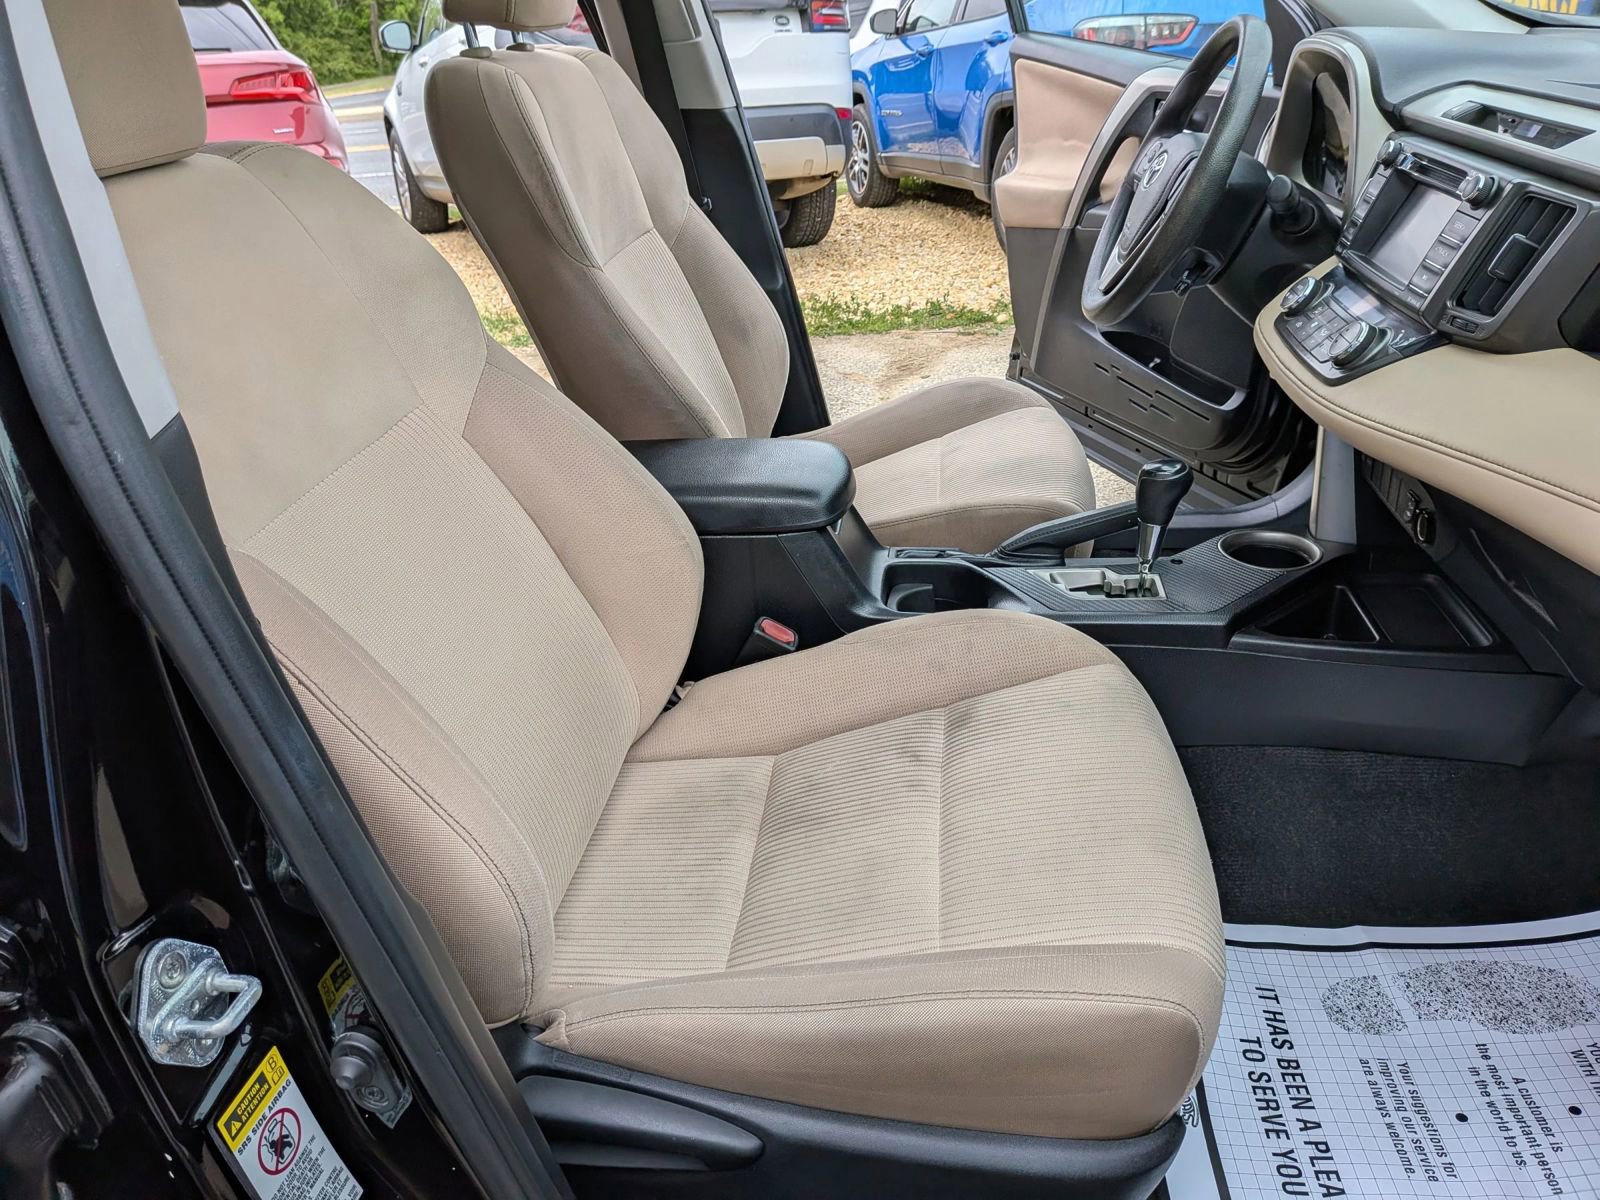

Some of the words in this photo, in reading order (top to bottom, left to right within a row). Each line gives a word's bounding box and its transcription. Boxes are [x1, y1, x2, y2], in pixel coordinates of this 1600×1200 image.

[1255, 987, 1280, 1005] IT
[1239, 1036, 1266, 1062] TO
[1262, 1009, 1294, 1050] HAS
[1276, 1058, 1316, 1110] BEEN
[1512, 1077, 1526, 1085] A
[1570, 1049, 1599, 1077] WITH
[236, 1081, 260, 1115] CAUTION
[238, 1134, 252, 1156] SRS
[251, 1113, 268, 1135] SIDE
[267, 1079, 292, 1115] AIRBAG
[241, 1083, 270, 1122] ATTENTION
[1248, 1071, 1291, 1140] SERVE
[1359, 1058, 1374, 1076] are
[1367, 1079, 1391, 1118] always
[1385, 1122, 1416, 1179] welcome.
[1376, 1058, 1408, 1113] improving
[1401, 1116, 1418, 1135] our
[1411, 1138, 1439, 1182] service
[1397, 1062, 1415, 1086] Your
[1408, 1089, 1447, 1158] suggestions
[1441, 1161, 1458, 1179] for
[1468, 1066, 1481, 1076] in
[1475, 1079, 1491, 1097] the
[1486, 1100, 1513, 1132] world
[1503, 1135, 1517, 1148] to
[1511, 1152, 1527, 1170] us.
[1475, 1043, 1491, 1061] the
[1486, 1064, 1510, 1090] most
[1502, 1094, 1542, 1149] important
[1530, 1151, 1563, 1195] person
[1518, 1087, 1555, 1138] customer
[1296, 1117, 1322, 1132] A
[1550, 1141, 1563, 1153] is
[1272, 1148, 1309, 1196] YOU
